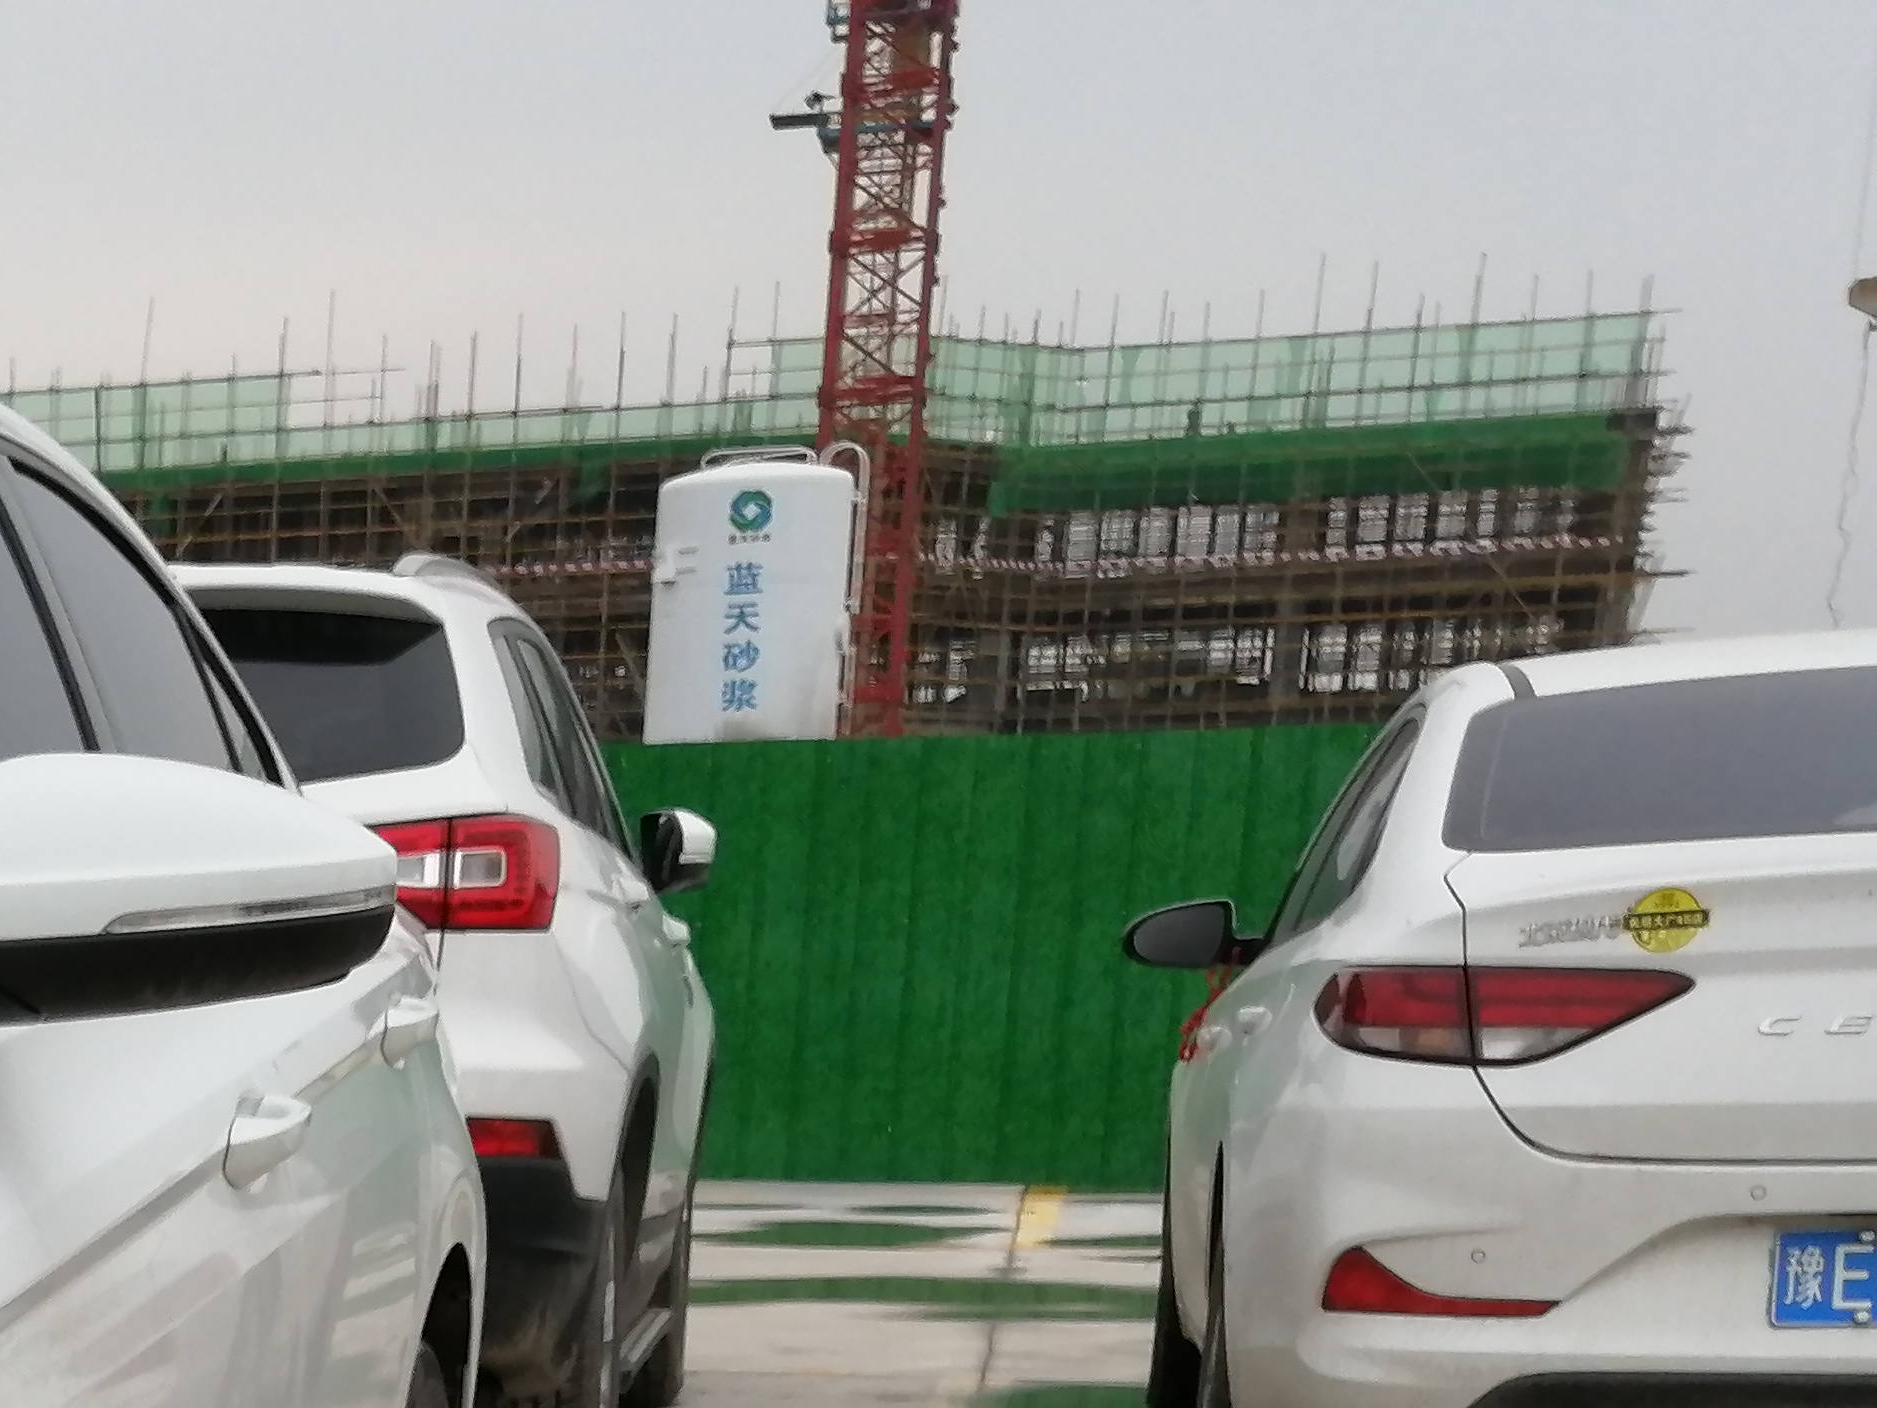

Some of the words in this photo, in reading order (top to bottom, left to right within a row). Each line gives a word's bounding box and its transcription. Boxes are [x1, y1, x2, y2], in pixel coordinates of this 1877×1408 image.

[720, 560, 764, 712] 蓝天砂浆
[1783, 1244, 1875, 1310] 豫E
